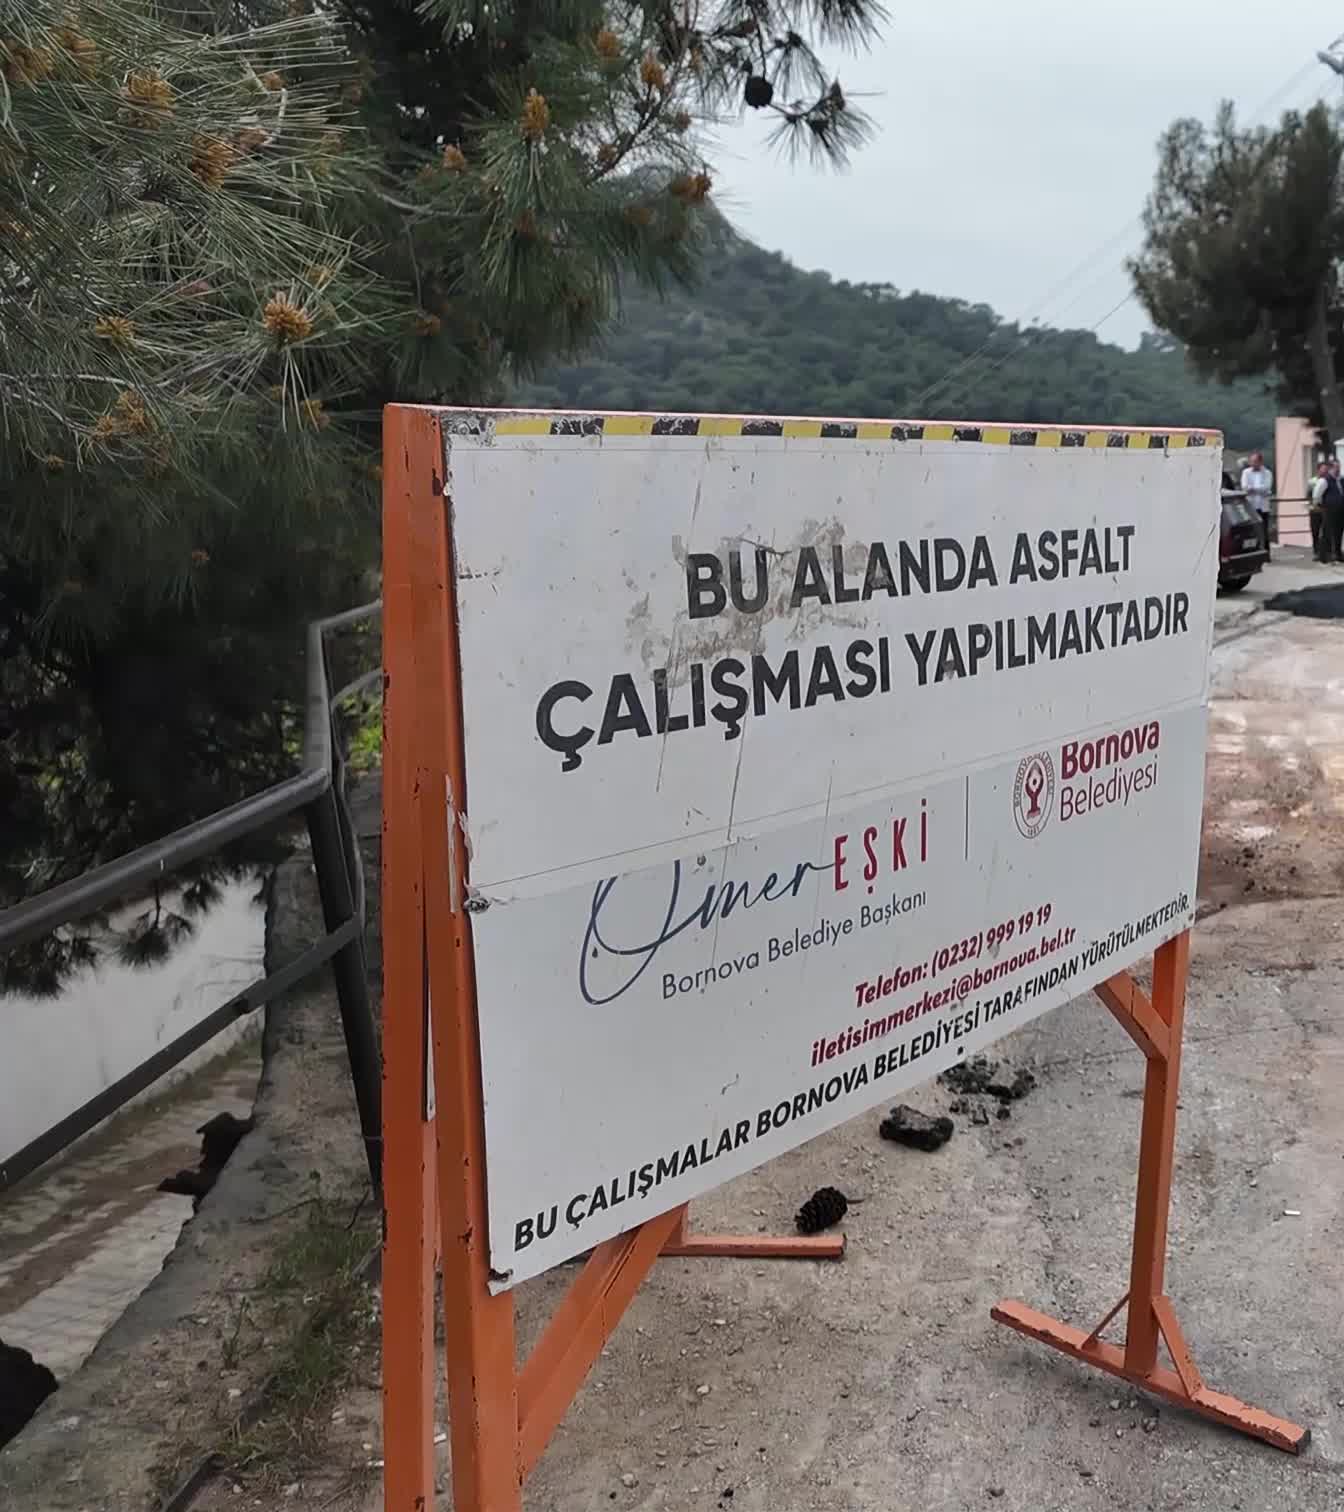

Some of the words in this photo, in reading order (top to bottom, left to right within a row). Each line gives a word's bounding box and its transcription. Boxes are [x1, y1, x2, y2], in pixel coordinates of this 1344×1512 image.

[687, 549, 769, 619] BU
[790, 536, 999, 608] ALANDA
[1009, 525, 1135, 584] ASFALT
[536, 637, 891, 772] ÇALIŞMASI
[904, 592, 1189, 686] YAPILMAKTADIR
[1060, 754, 1158, 821] Belediyesi
[1061, 721, 1160, 780] Bornova
[834, 799, 927, 894] EŞKİ
[663, 952, 760, 999] Bornova
[768, 919, 853, 963] Belediye
[860, 892, 926, 928] Başkanı
[811, 926, 1077, 1067] iletisimmerkezi@bornova.bel.tr
[855, 963, 928, 1008] Telefon:
[931, 932, 984, 978] (0232)
[986, 922, 1016, 950] 999
[1018, 912, 1034, 936] 19
[1036, 903, 1052, 926] 19
[514, 1206, 559, 1252] BU
[565, 1119, 751, 1229] ÇALIŞMALAR
[756, 1063, 869, 1138] BORNOVA
[873, 999, 981, 1081] BELEDİYESİ
[983, 960, 1080, 1022] TARAFINDAN
[1081, 892, 1190, 969] YÜRÜTÜLMEKTEDİR.
